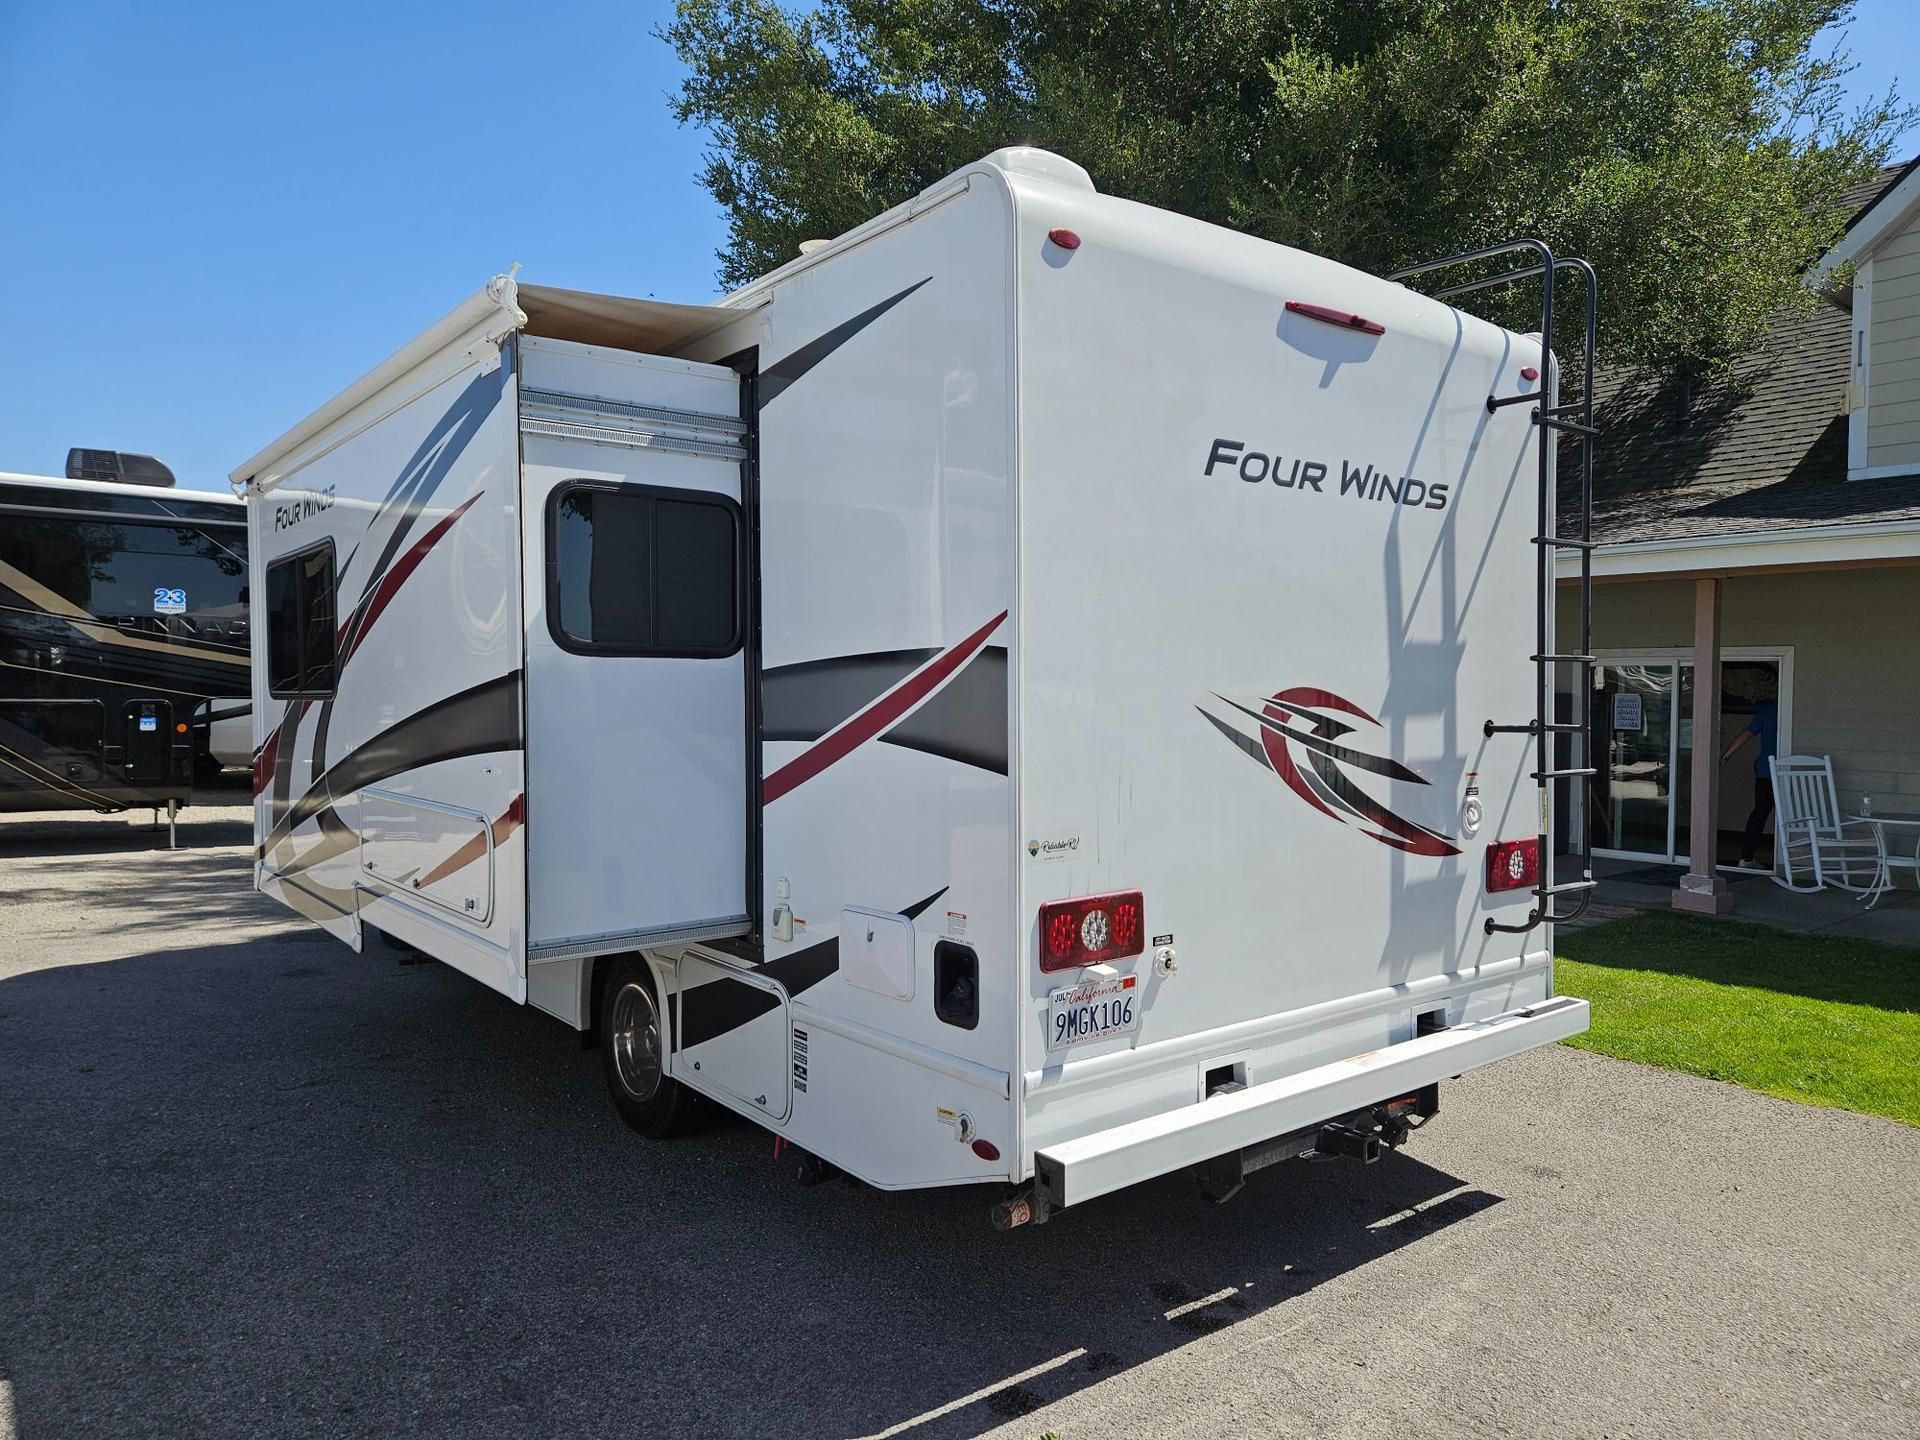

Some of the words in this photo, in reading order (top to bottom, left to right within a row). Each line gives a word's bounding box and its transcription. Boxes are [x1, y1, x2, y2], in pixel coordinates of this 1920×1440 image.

[1204, 438, 1328, 493] FOUR
[1340, 459, 1450, 511] WINDS
[275, 502, 301, 533] FOUR
[303, 483, 336, 520] WINDS
[1055, 991, 1067, 1003] JUL
[1068, 985, 1122, 1004] California
[1055, 996, 1133, 1043] 9MGK106
[1071, 1028, 1118, 1044] dmv.ca.gov
